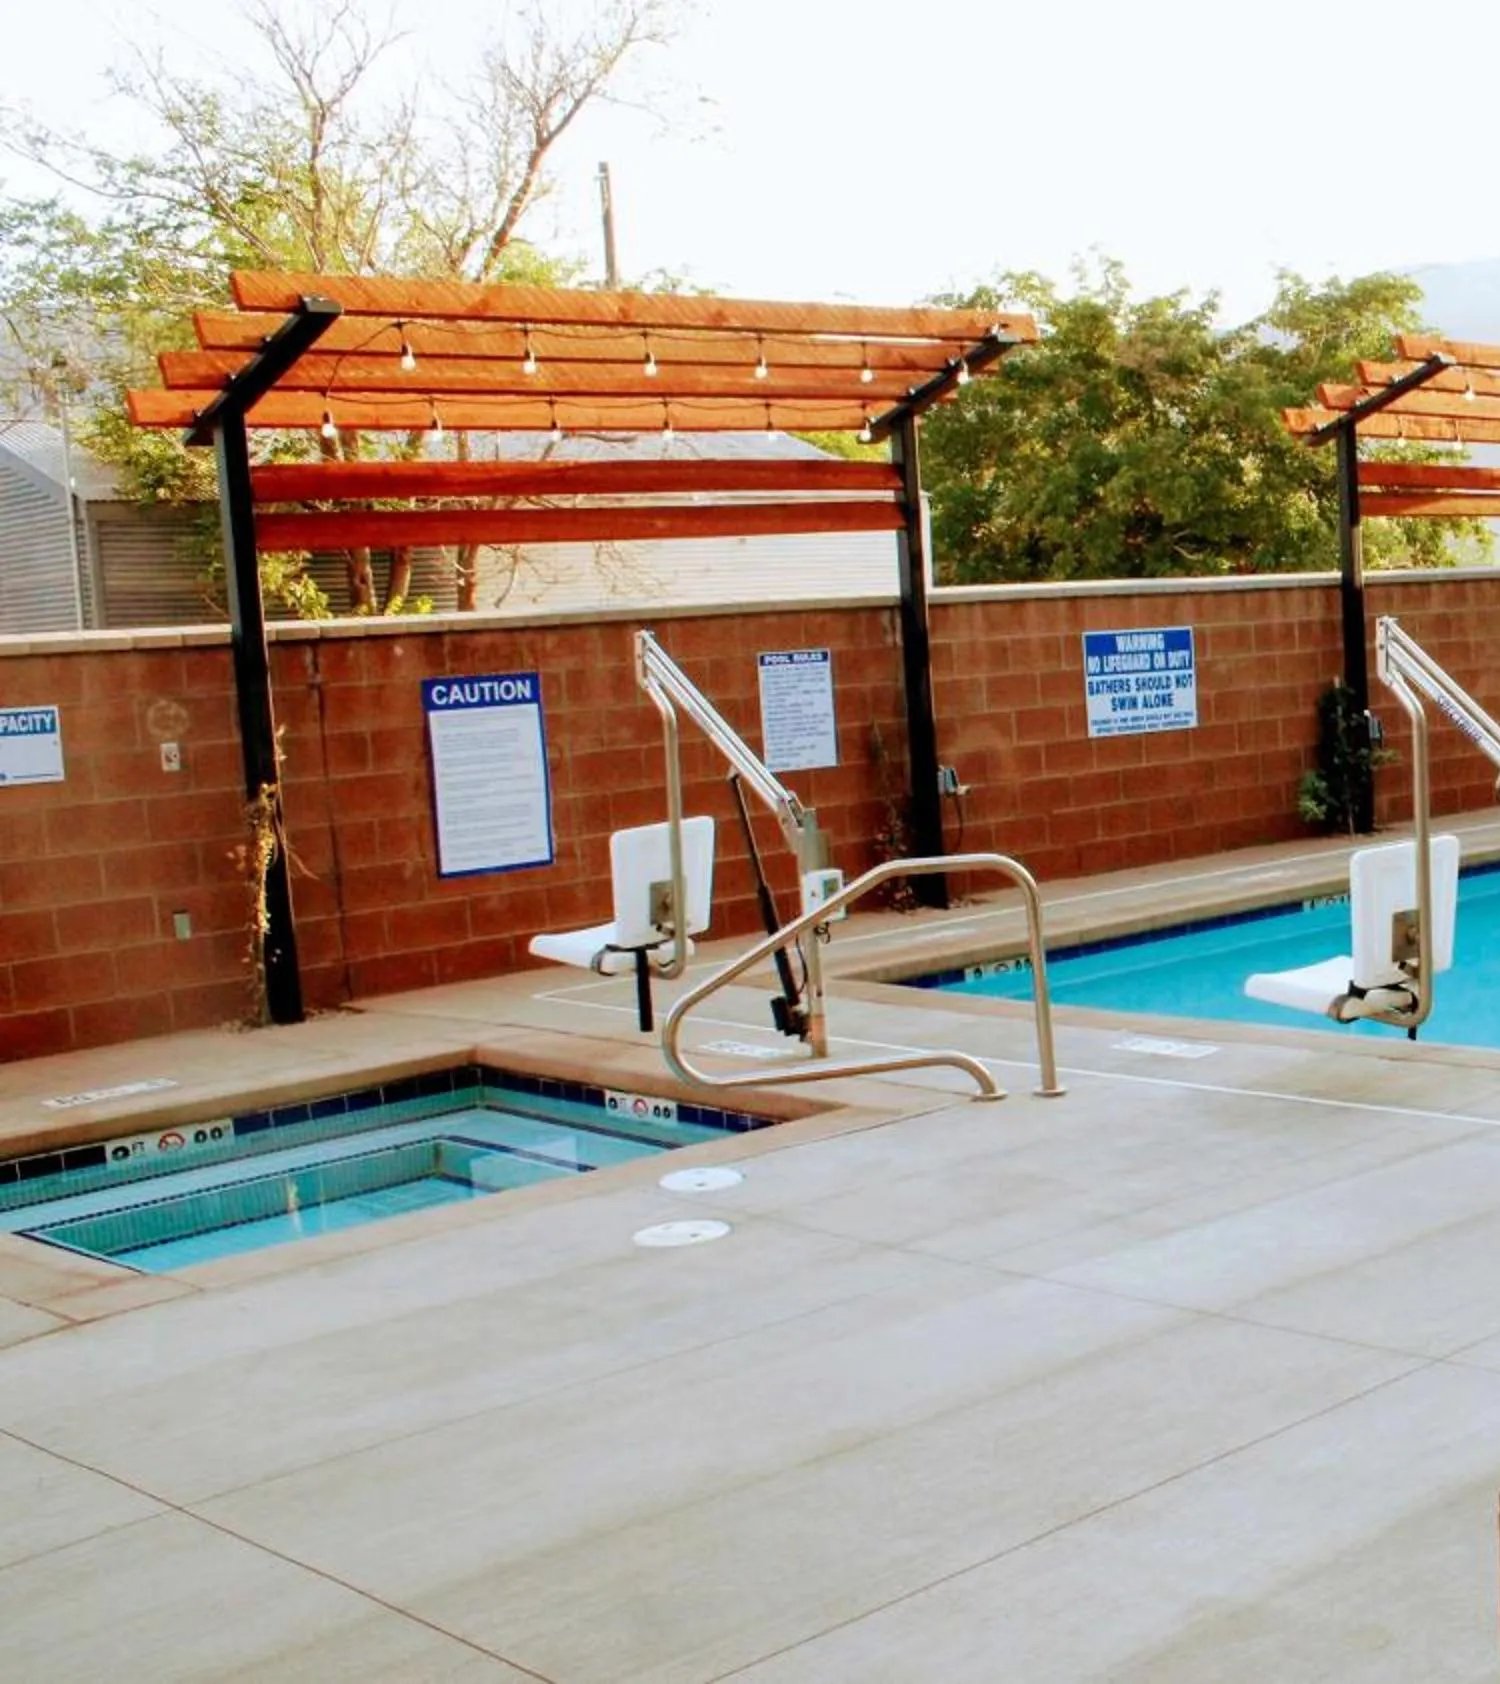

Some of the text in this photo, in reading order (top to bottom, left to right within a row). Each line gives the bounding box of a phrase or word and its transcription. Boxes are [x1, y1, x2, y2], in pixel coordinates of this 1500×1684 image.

[1115, 633, 1165, 652] WARNING
[763, 655, 791, 665] POOL
[1087, 650, 1190, 674] NO LIFEGUARD ON DUTY
[430, 679, 532, 705] CAUTION
[1087, 672, 1193, 696] BATHERS SHOULD NOT
[1110, 692, 1174, 712] SWIM ALONE
